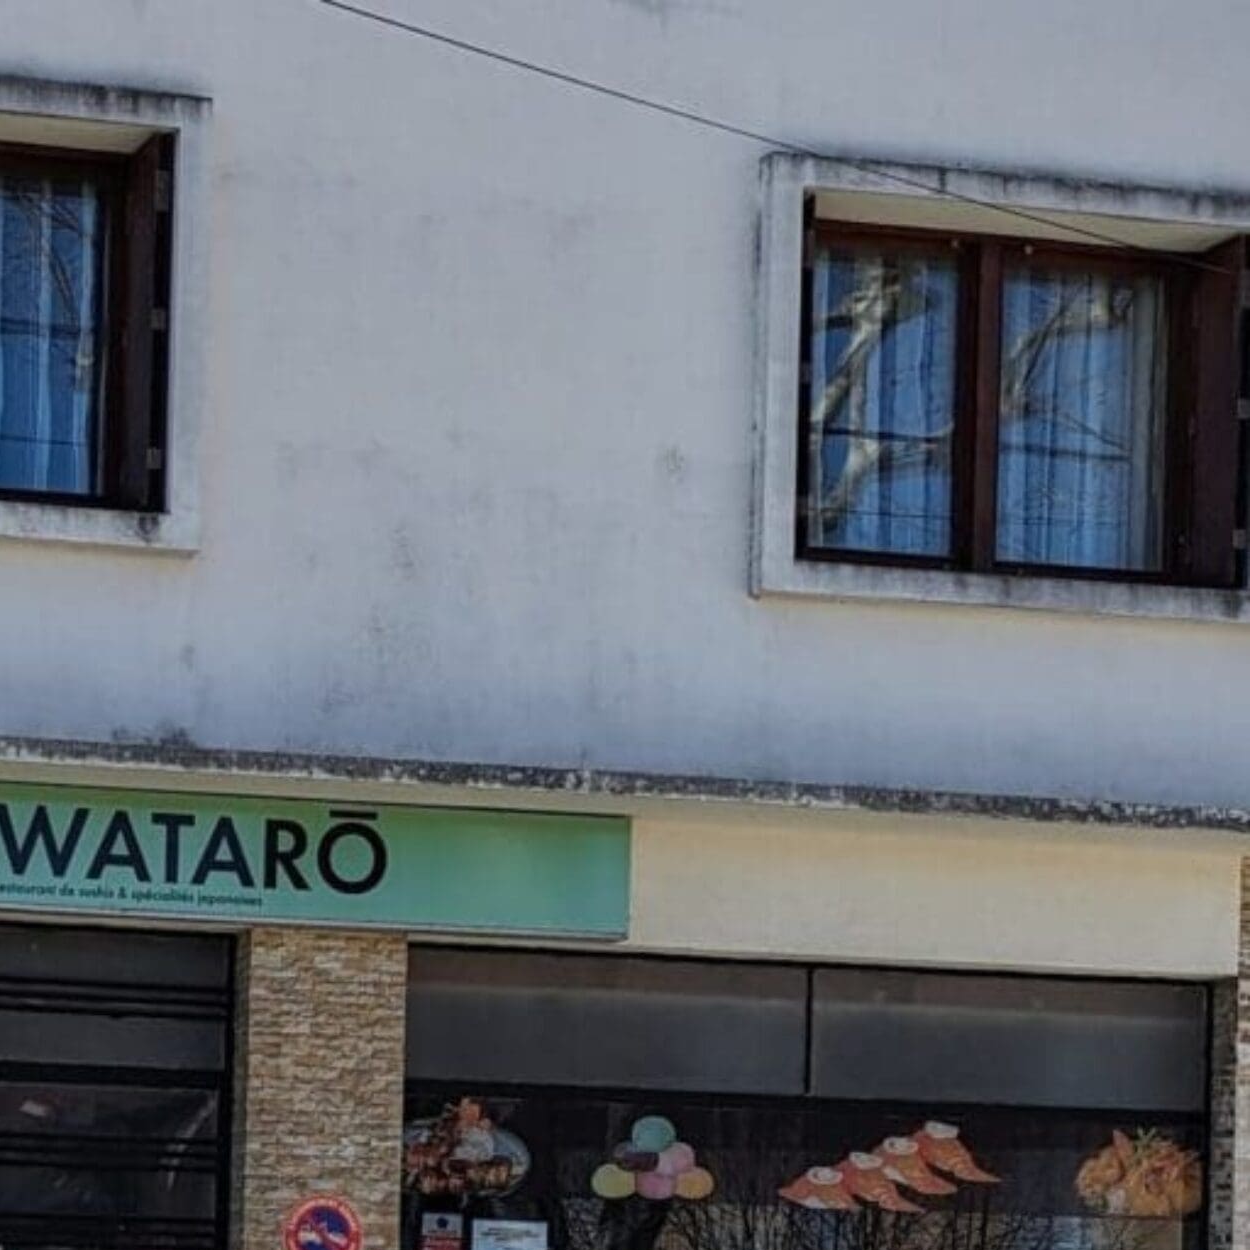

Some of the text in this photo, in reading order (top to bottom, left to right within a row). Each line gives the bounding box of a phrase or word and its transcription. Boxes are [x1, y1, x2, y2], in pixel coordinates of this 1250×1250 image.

[58, 882, 75, 896] de
[78, 885, 114, 899] sushis
[117, 885, 126, 899] &
